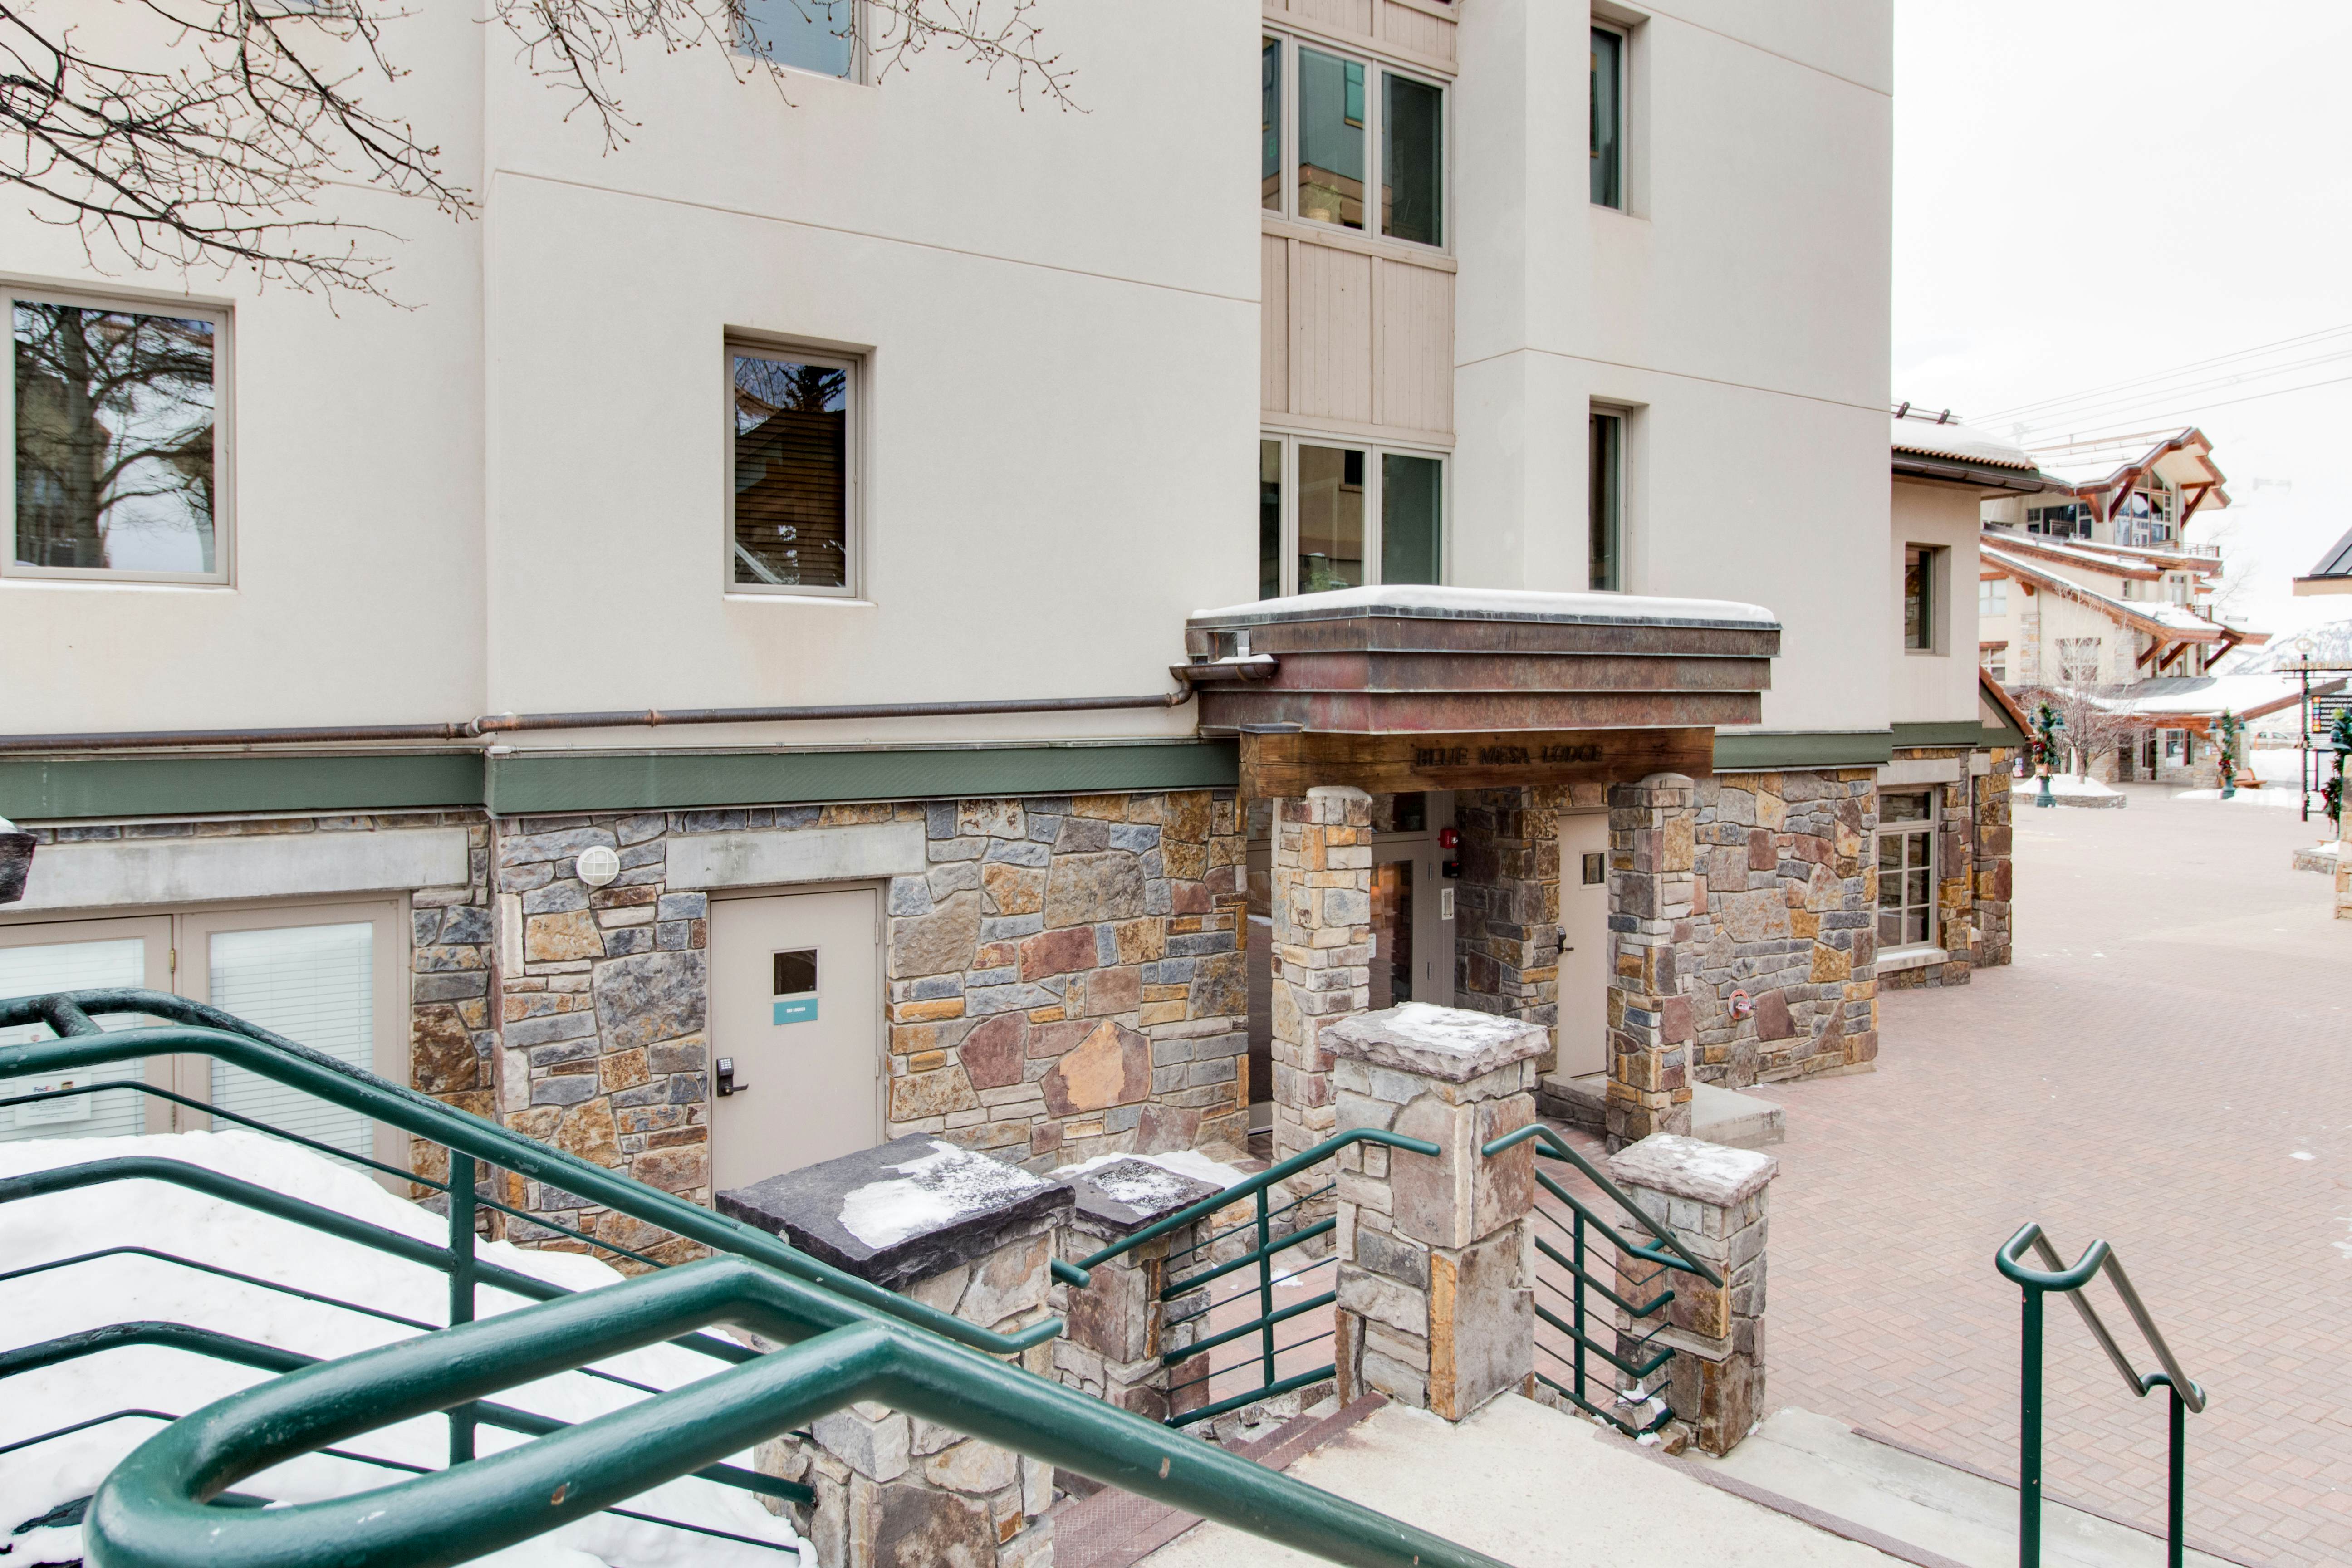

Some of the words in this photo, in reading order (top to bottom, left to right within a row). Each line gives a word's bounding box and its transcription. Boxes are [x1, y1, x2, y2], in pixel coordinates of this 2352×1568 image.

[2281, 662, 2329, 670] SUNSET
[1416, 747, 1469, 767] BLUE
[1479, 747, 1531, 765] MESA
[1542, 745, 1603, 763] LODGE
